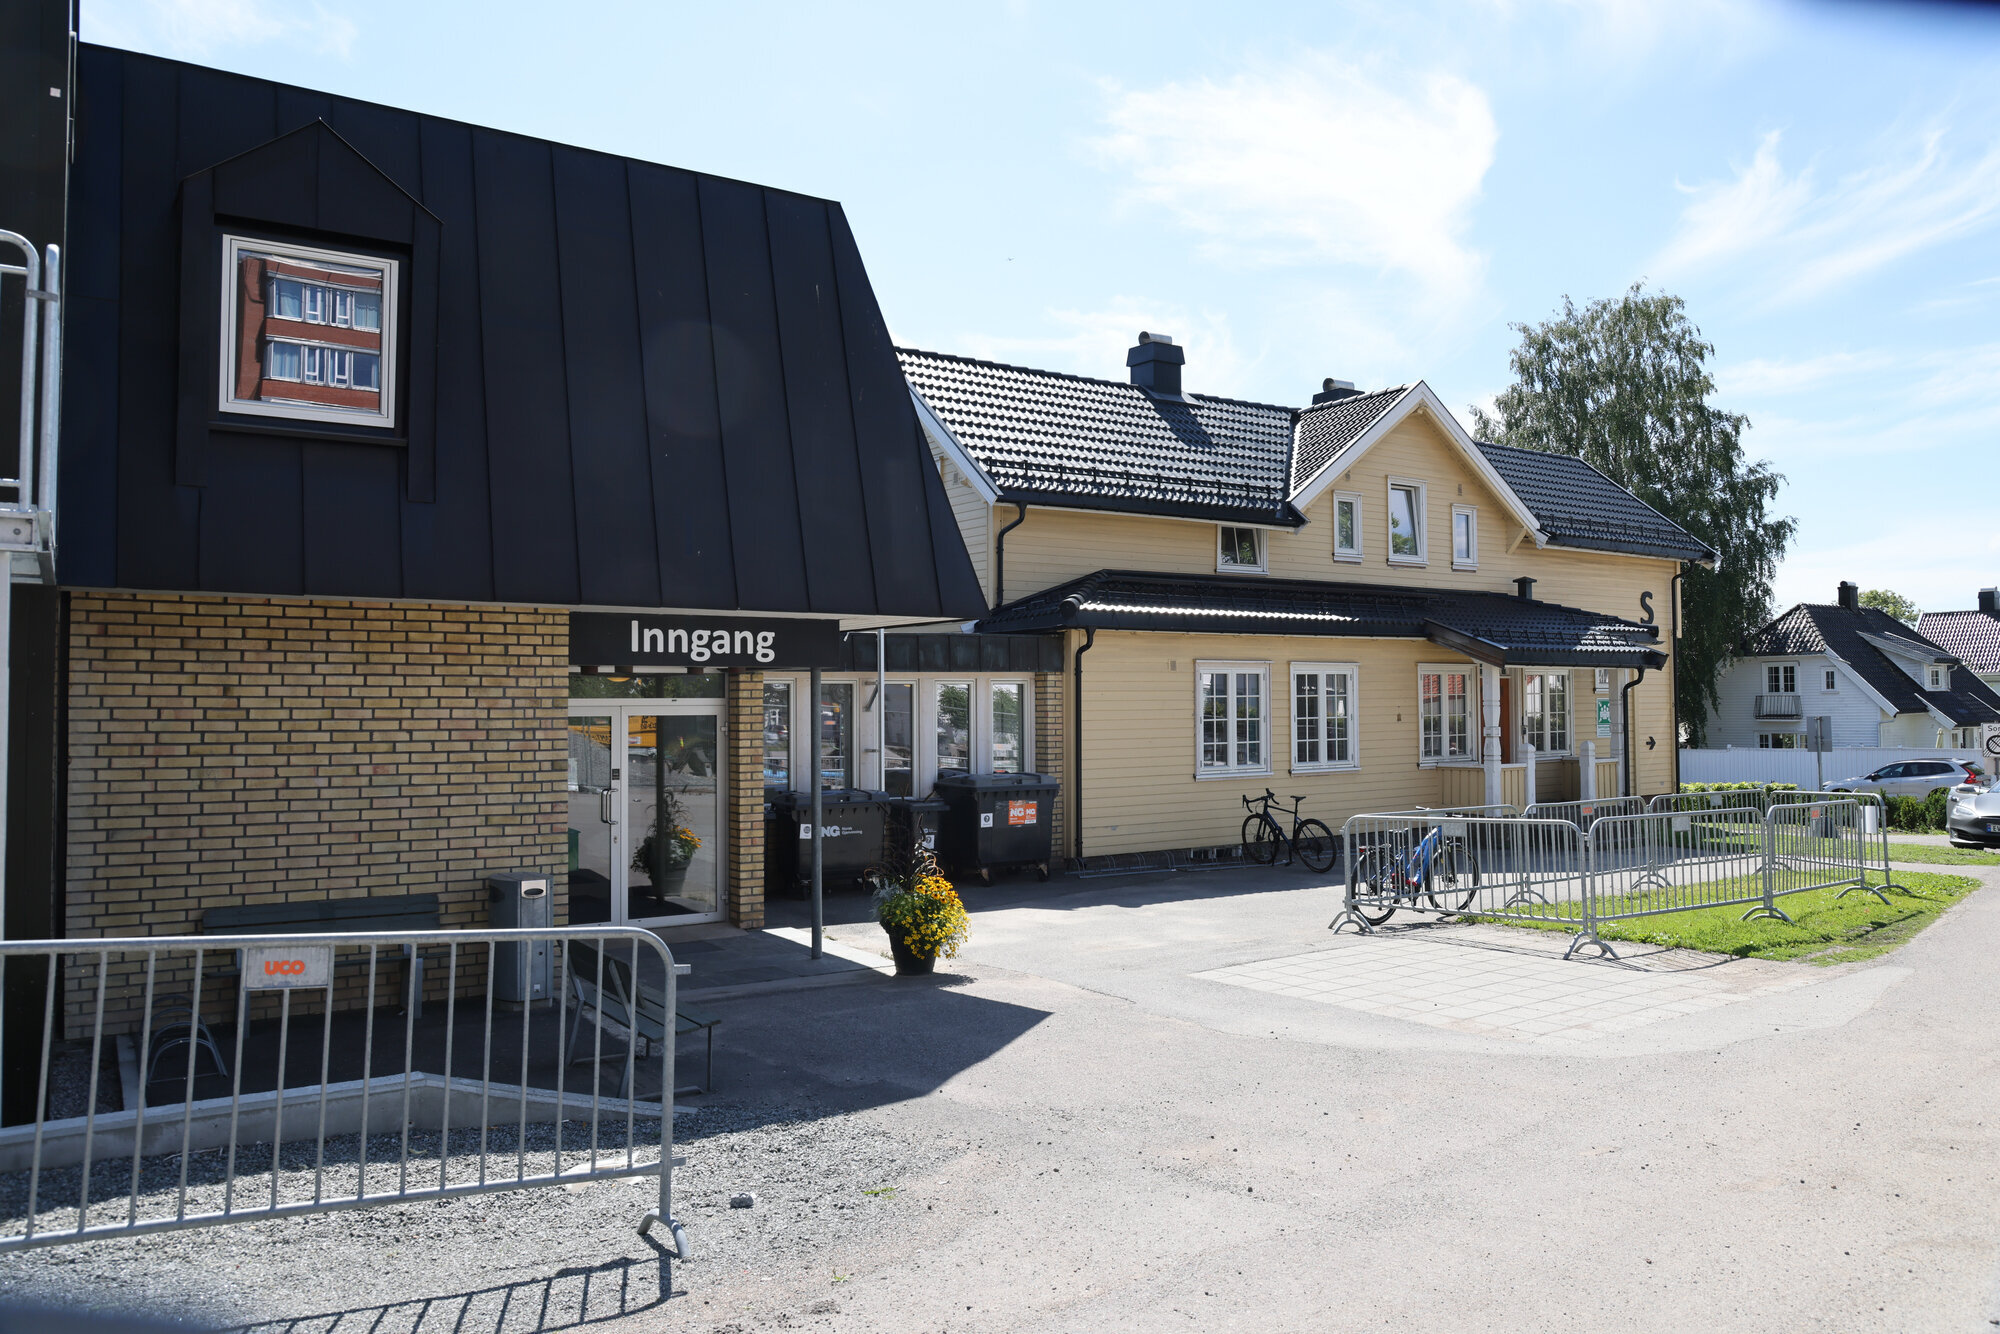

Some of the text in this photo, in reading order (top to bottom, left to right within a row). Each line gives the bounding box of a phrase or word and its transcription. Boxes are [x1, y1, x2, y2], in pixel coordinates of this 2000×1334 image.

[630, 619, 776, 663] Inngang
[821, 825, 840, 837] NG
[264, 960, 306, 976] UCO
